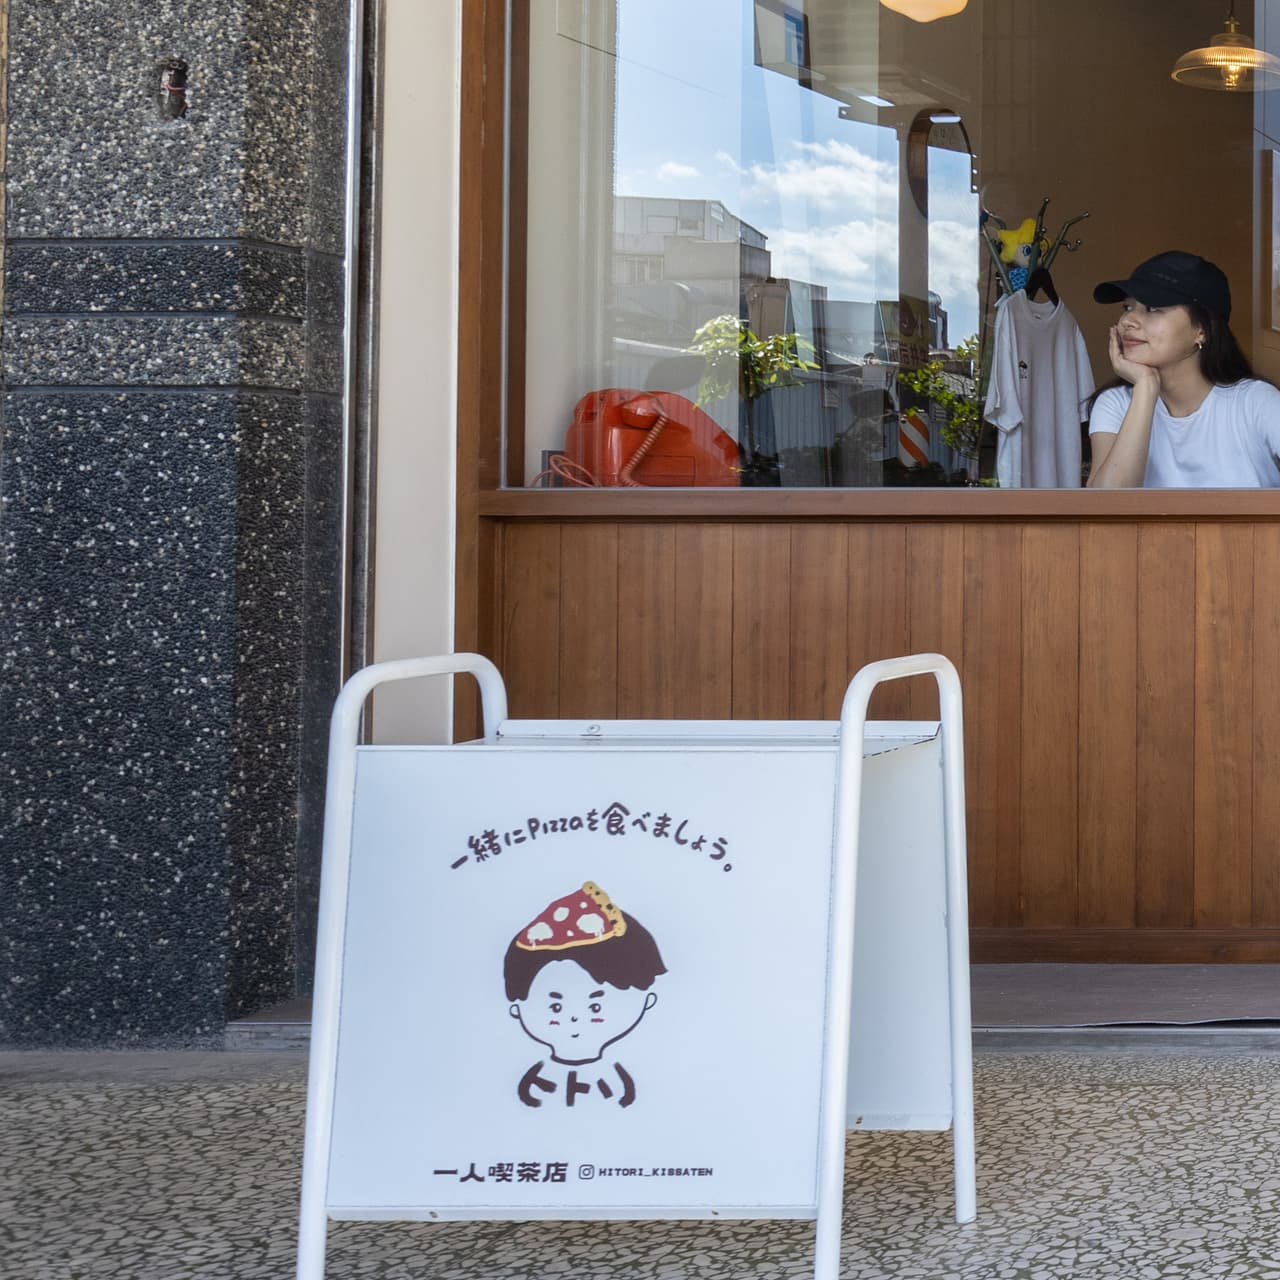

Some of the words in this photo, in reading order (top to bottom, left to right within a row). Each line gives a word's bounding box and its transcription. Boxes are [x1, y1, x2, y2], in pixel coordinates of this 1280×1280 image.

[517, 1060, 636, 1108] ヒトリ
[433, 1162, 569, 1183] 一人喫茶店
[598, 1167, 714, 1177] HITORI_KISSATEN
